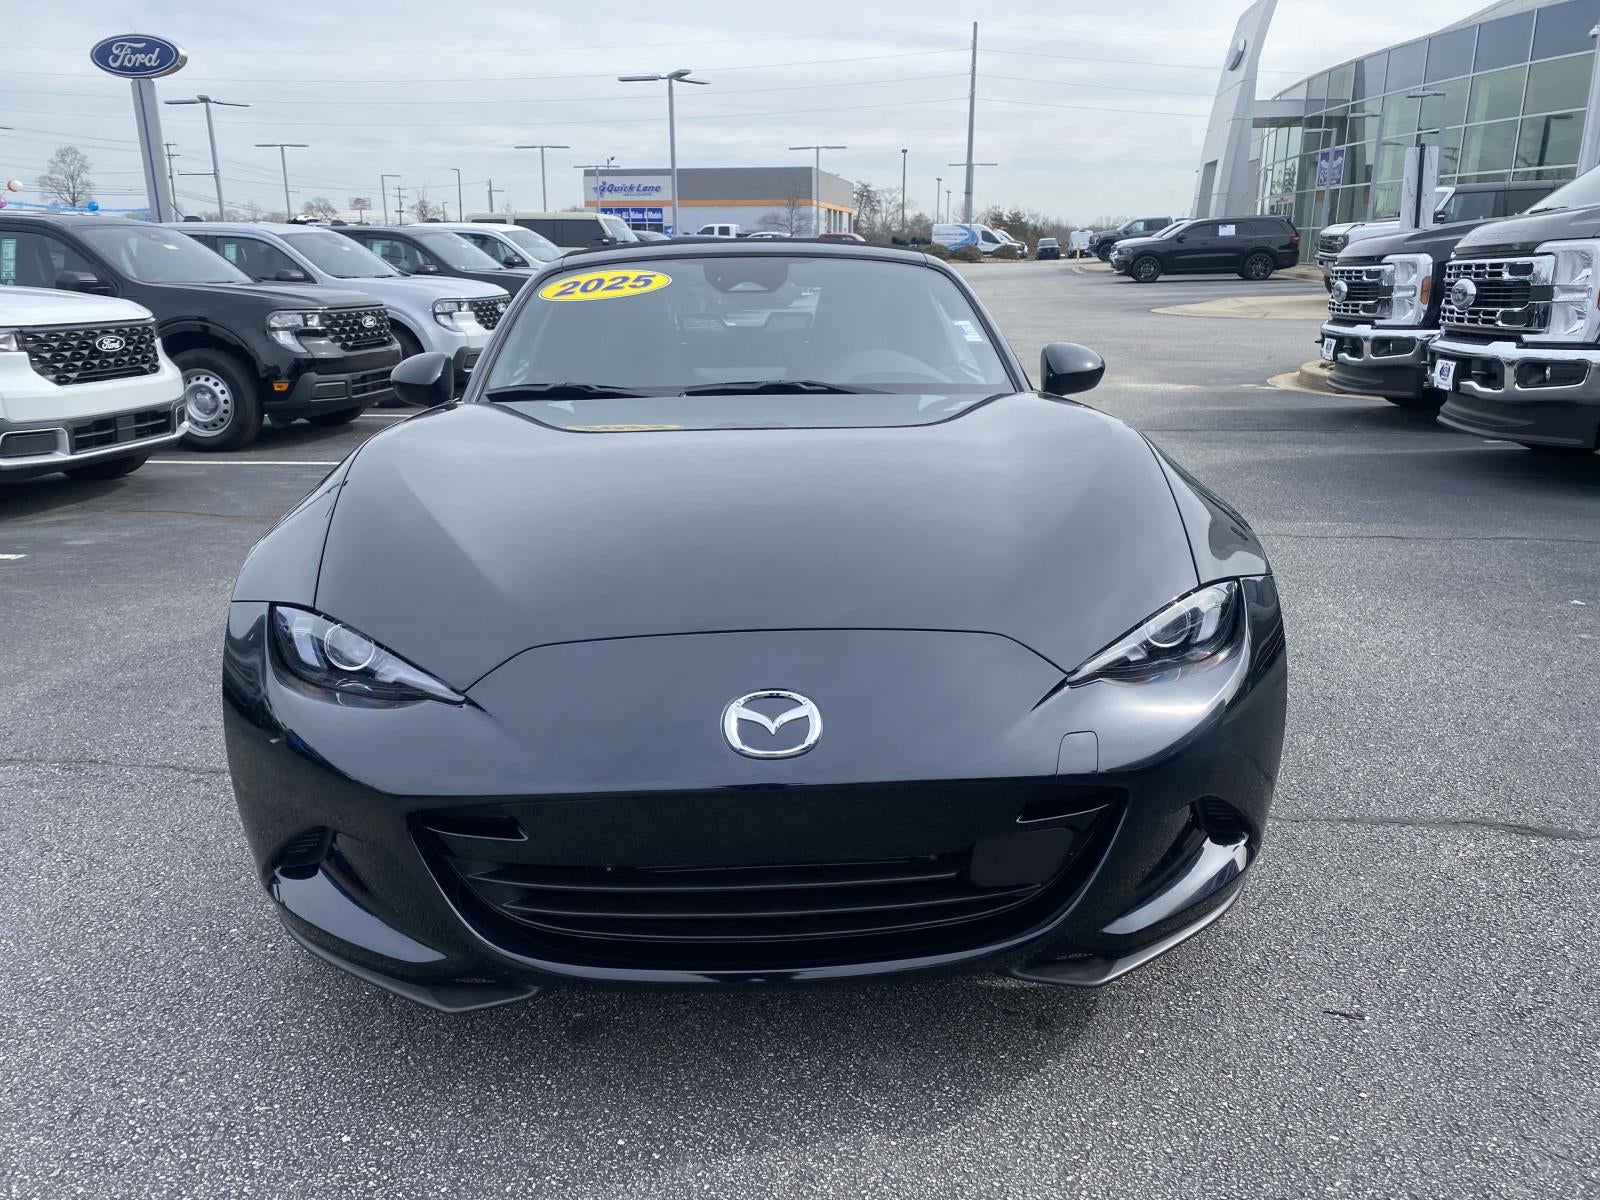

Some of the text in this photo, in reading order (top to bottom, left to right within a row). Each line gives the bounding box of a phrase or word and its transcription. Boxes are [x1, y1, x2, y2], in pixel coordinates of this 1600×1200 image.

[108, 42, 160, 68] Ford
[607, 184, 661, 193] Quick Lane
[552, 274, 656, 297] 2025
[102, 338, 120, 349] Ford
